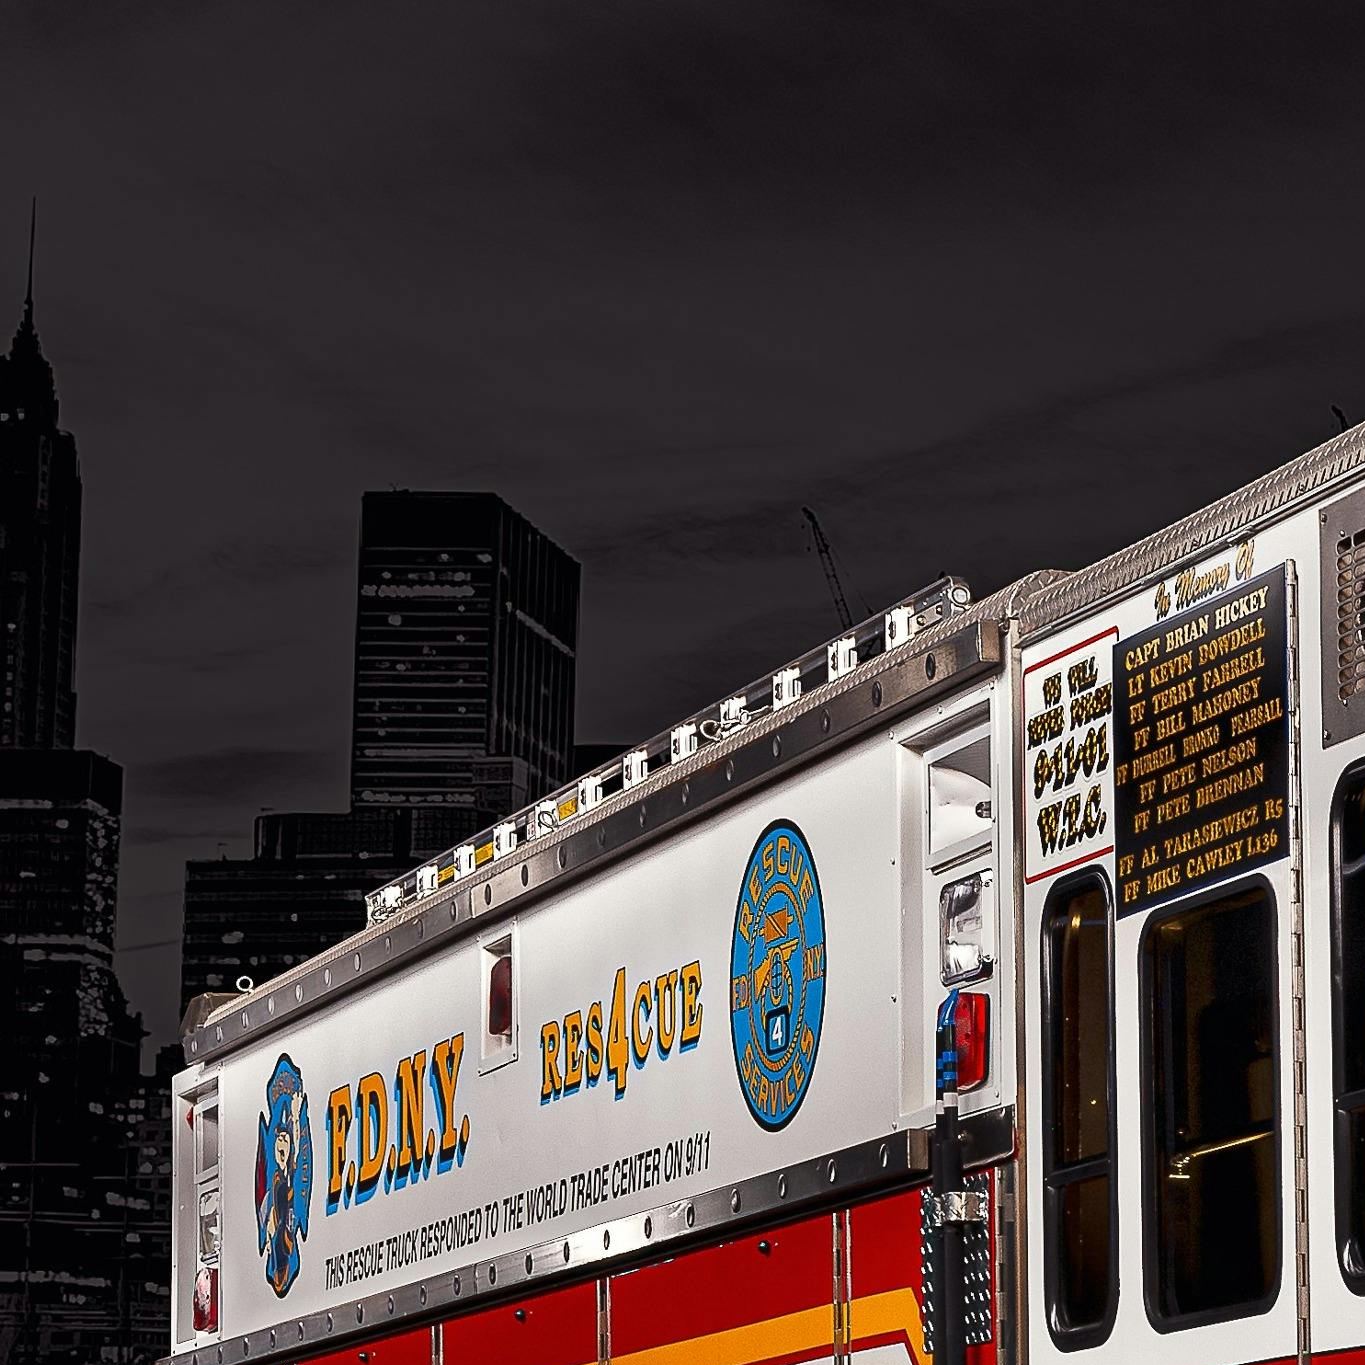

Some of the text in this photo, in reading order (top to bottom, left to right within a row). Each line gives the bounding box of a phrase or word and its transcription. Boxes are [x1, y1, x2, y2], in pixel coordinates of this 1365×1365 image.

[1154, 541, 1255, 621] In Memory Of
[1125, 586, 1269, 671] CAPT BRIAN HICKEY
[1128, 618, 1265, 698] LT KEVIN DOWDELL
[1067, 656, 1098, 698] WILL
[1130, 647, 1265, 725] FF TERRY FARRELL
[1134, 677, 1262, 750] FF BILL MAHONEY
[1116, 764, 1128, 787] FF
[1132, 743, 1176, 779] DURRELL
[1231, 697, 1283, 737] PEARSALL
[1140, 737, 1257, 804] FF PETE NELSON
[1119, 798, 1283, 878] FF AL TARASIEWICZ R5
[1134, 763, 1265, 833] FF PETE BRENNAN
[738, 836, 814, 942] RESCUE
[1123, 828, 1278, 903] FF MIKE CAWLEY L136
[740, 1023, 814, 1116] SERVICES
[771, 1016, 783, 1046] 4
[325, 1032, 470, 1217] F.D.N.Y.
[325, 1130, 711, 1290] THIS RESCUE TRUCK RESPONDED TO THE WORLD TRADE CENTER ON 9/11
